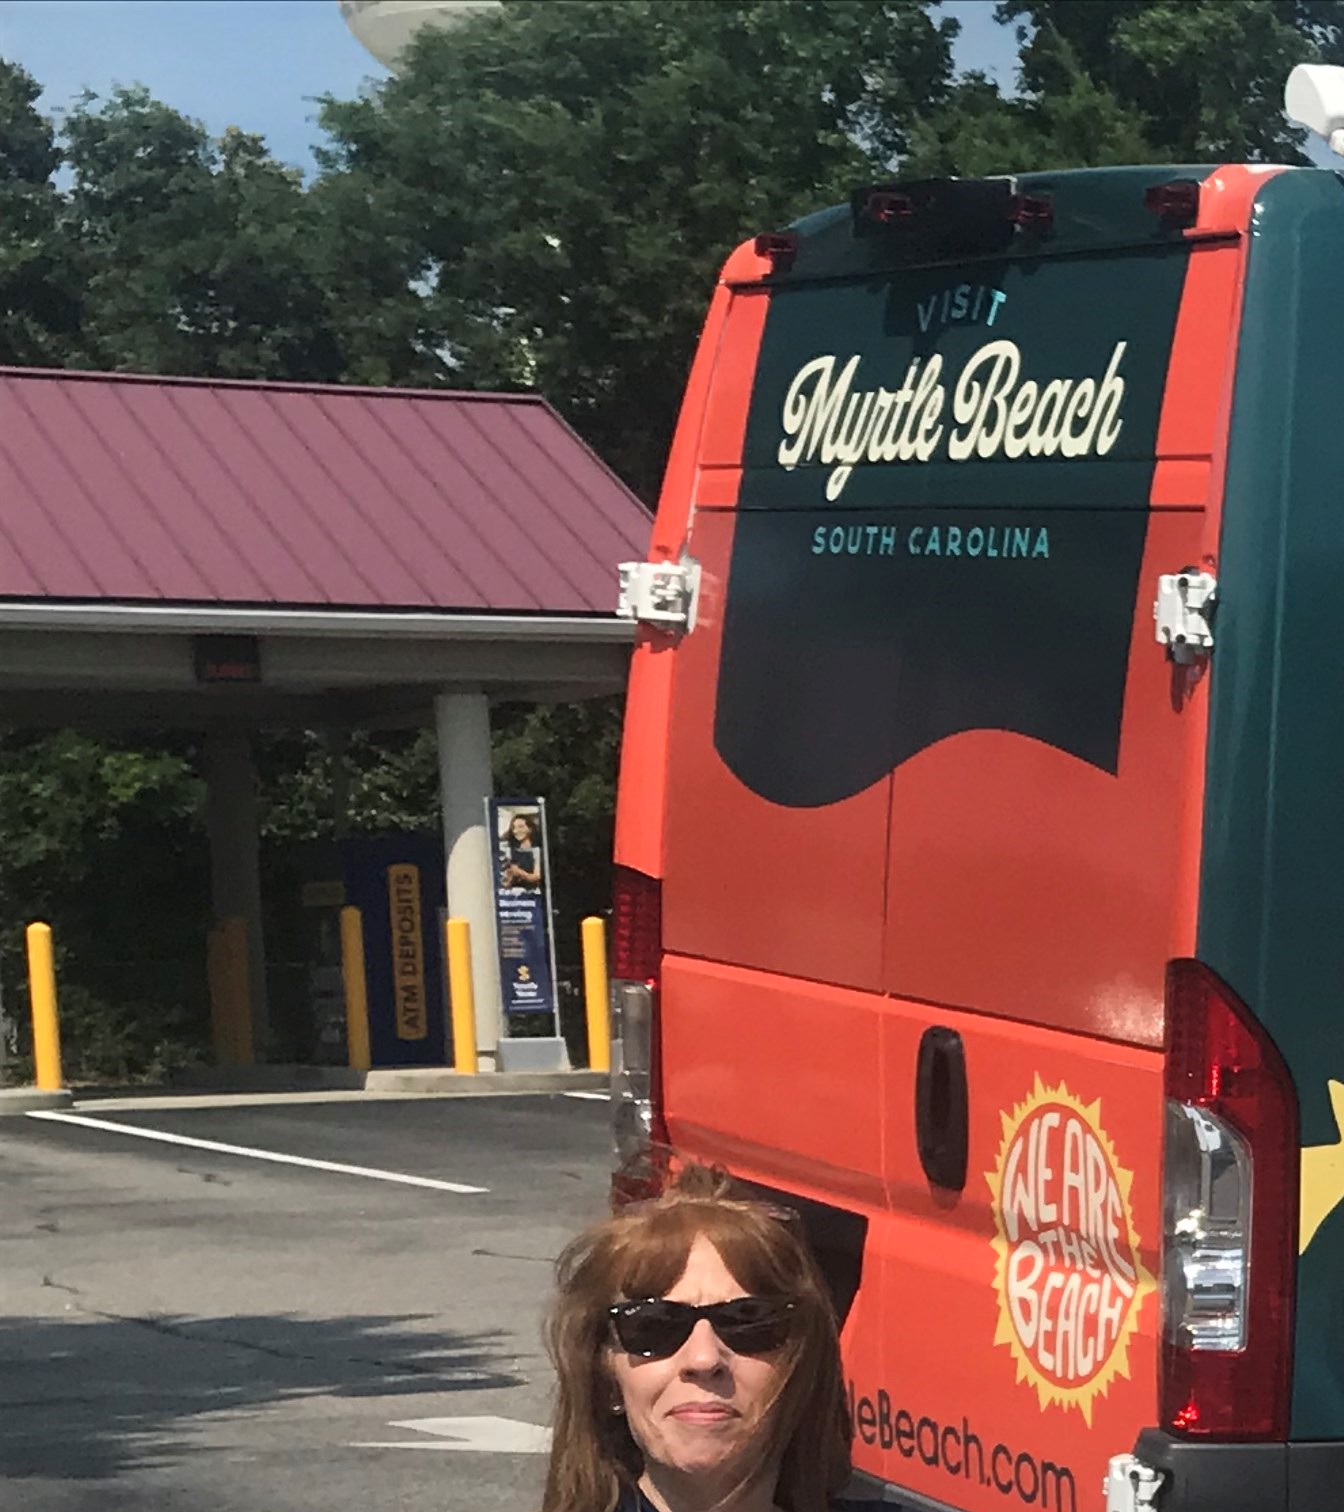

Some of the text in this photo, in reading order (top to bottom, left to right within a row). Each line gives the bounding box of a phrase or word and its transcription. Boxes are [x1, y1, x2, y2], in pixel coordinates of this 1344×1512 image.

[917, 287, 1006, 332] VISIT
[778, 339, 1128, 501] Myrtle Beach
[811, 525, 1051, 559] SOUTH CAROLINA
[395, 872, 420, 1030] ATM DEPOSITS
[1002, 1112, 1136, 1299] WE ARE
[1038, 1226, 1102, 1279] THE
[1007, 1240, 1124, 1381] BEACH
